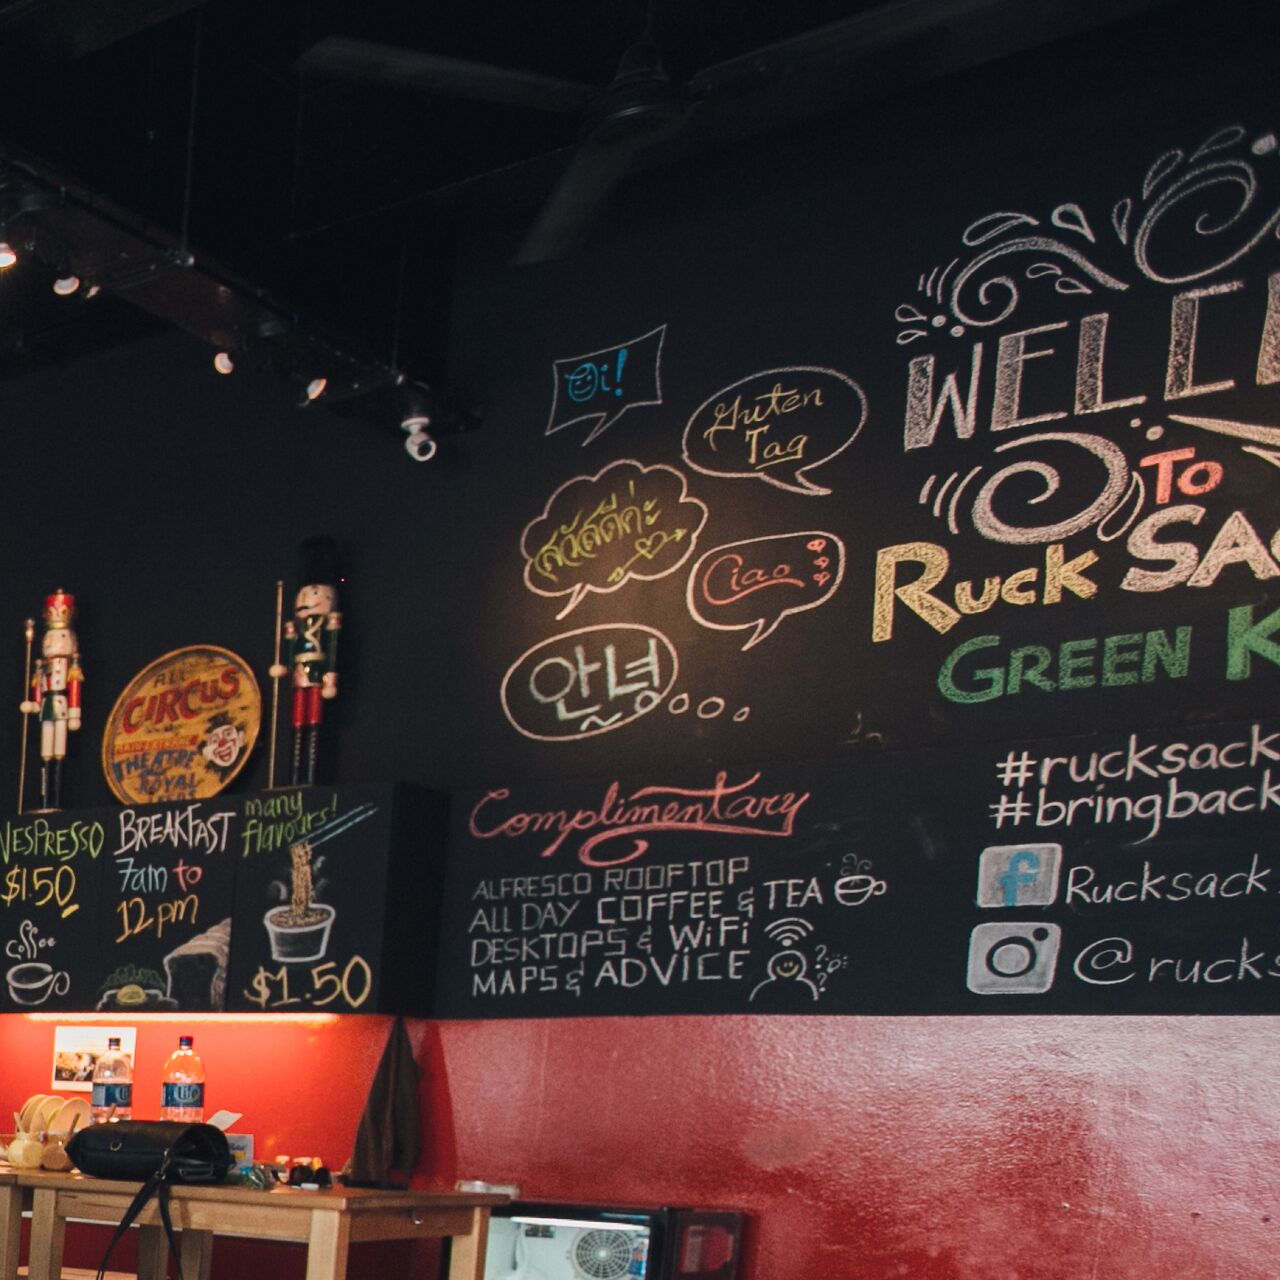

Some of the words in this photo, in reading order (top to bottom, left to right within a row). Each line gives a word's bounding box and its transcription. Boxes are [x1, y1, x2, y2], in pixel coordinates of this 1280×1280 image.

[703, 383, 824, 451] Guten
[745, 425, 809, 466] Tag
[1120, 504, 1280, 592] SA
[703, 554, 793, 604] Ciao
[938, 626, 1192, 703] GREEN
[121, 666, 240, 734] CIRCUS
[113, 803, 237, 855] BREAKFAST
[244, 792, 303, 825] many
[470, 771, 810, 866] Complimentary
[115, 858, 168, 892] 7am
[173, 860, 202, 892] to
[472, 872, 591, 900] ALFRESCO
[604, 856, 749, 893] ROOFTOP
[1066, 853, 1271, 904] Rucksack
[468, 908, 512, 933] ALL
[522, 900, 581, 932] DAY
[597, 891, 723, 925] COFFEE
[764, 877, 824, 910] TEA
[471, 928, 626, 968] DESKTOPS
[245, 955, 372, 1009] $1.50
[472, 966, 558, 997] MAPS
